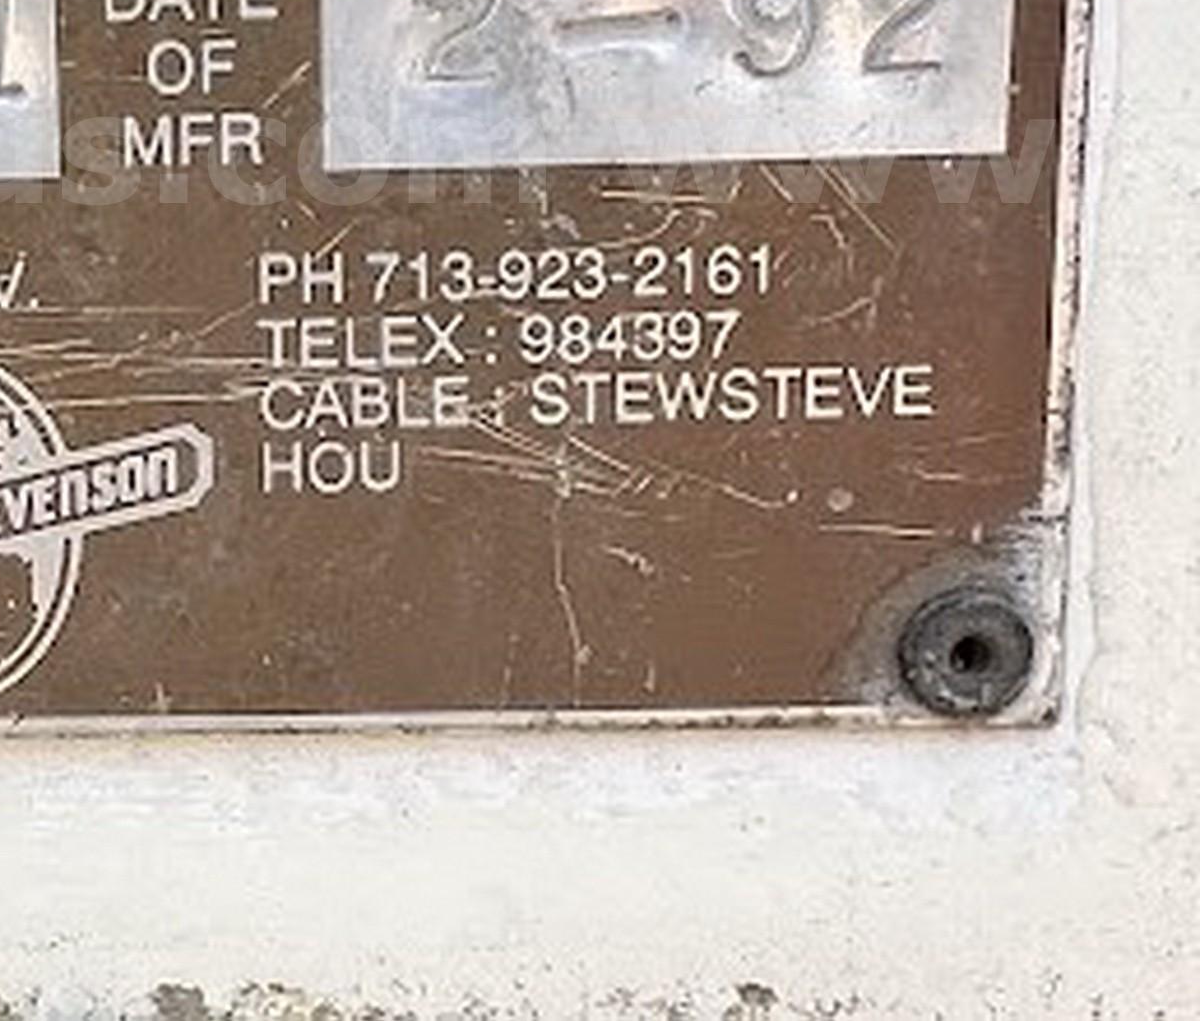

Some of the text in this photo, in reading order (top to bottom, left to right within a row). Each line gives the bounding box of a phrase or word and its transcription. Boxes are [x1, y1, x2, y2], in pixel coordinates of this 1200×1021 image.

[147, 39, 237, 95] OF
[123, 112, 263, 169] MFR
[259, 245, 769, 304] PH 713-923-2161
[519, 309, 741, 364] 984397
[529, 362, 934, 422] STEWSTEVE
[263, 440, 400, 493] HOU
